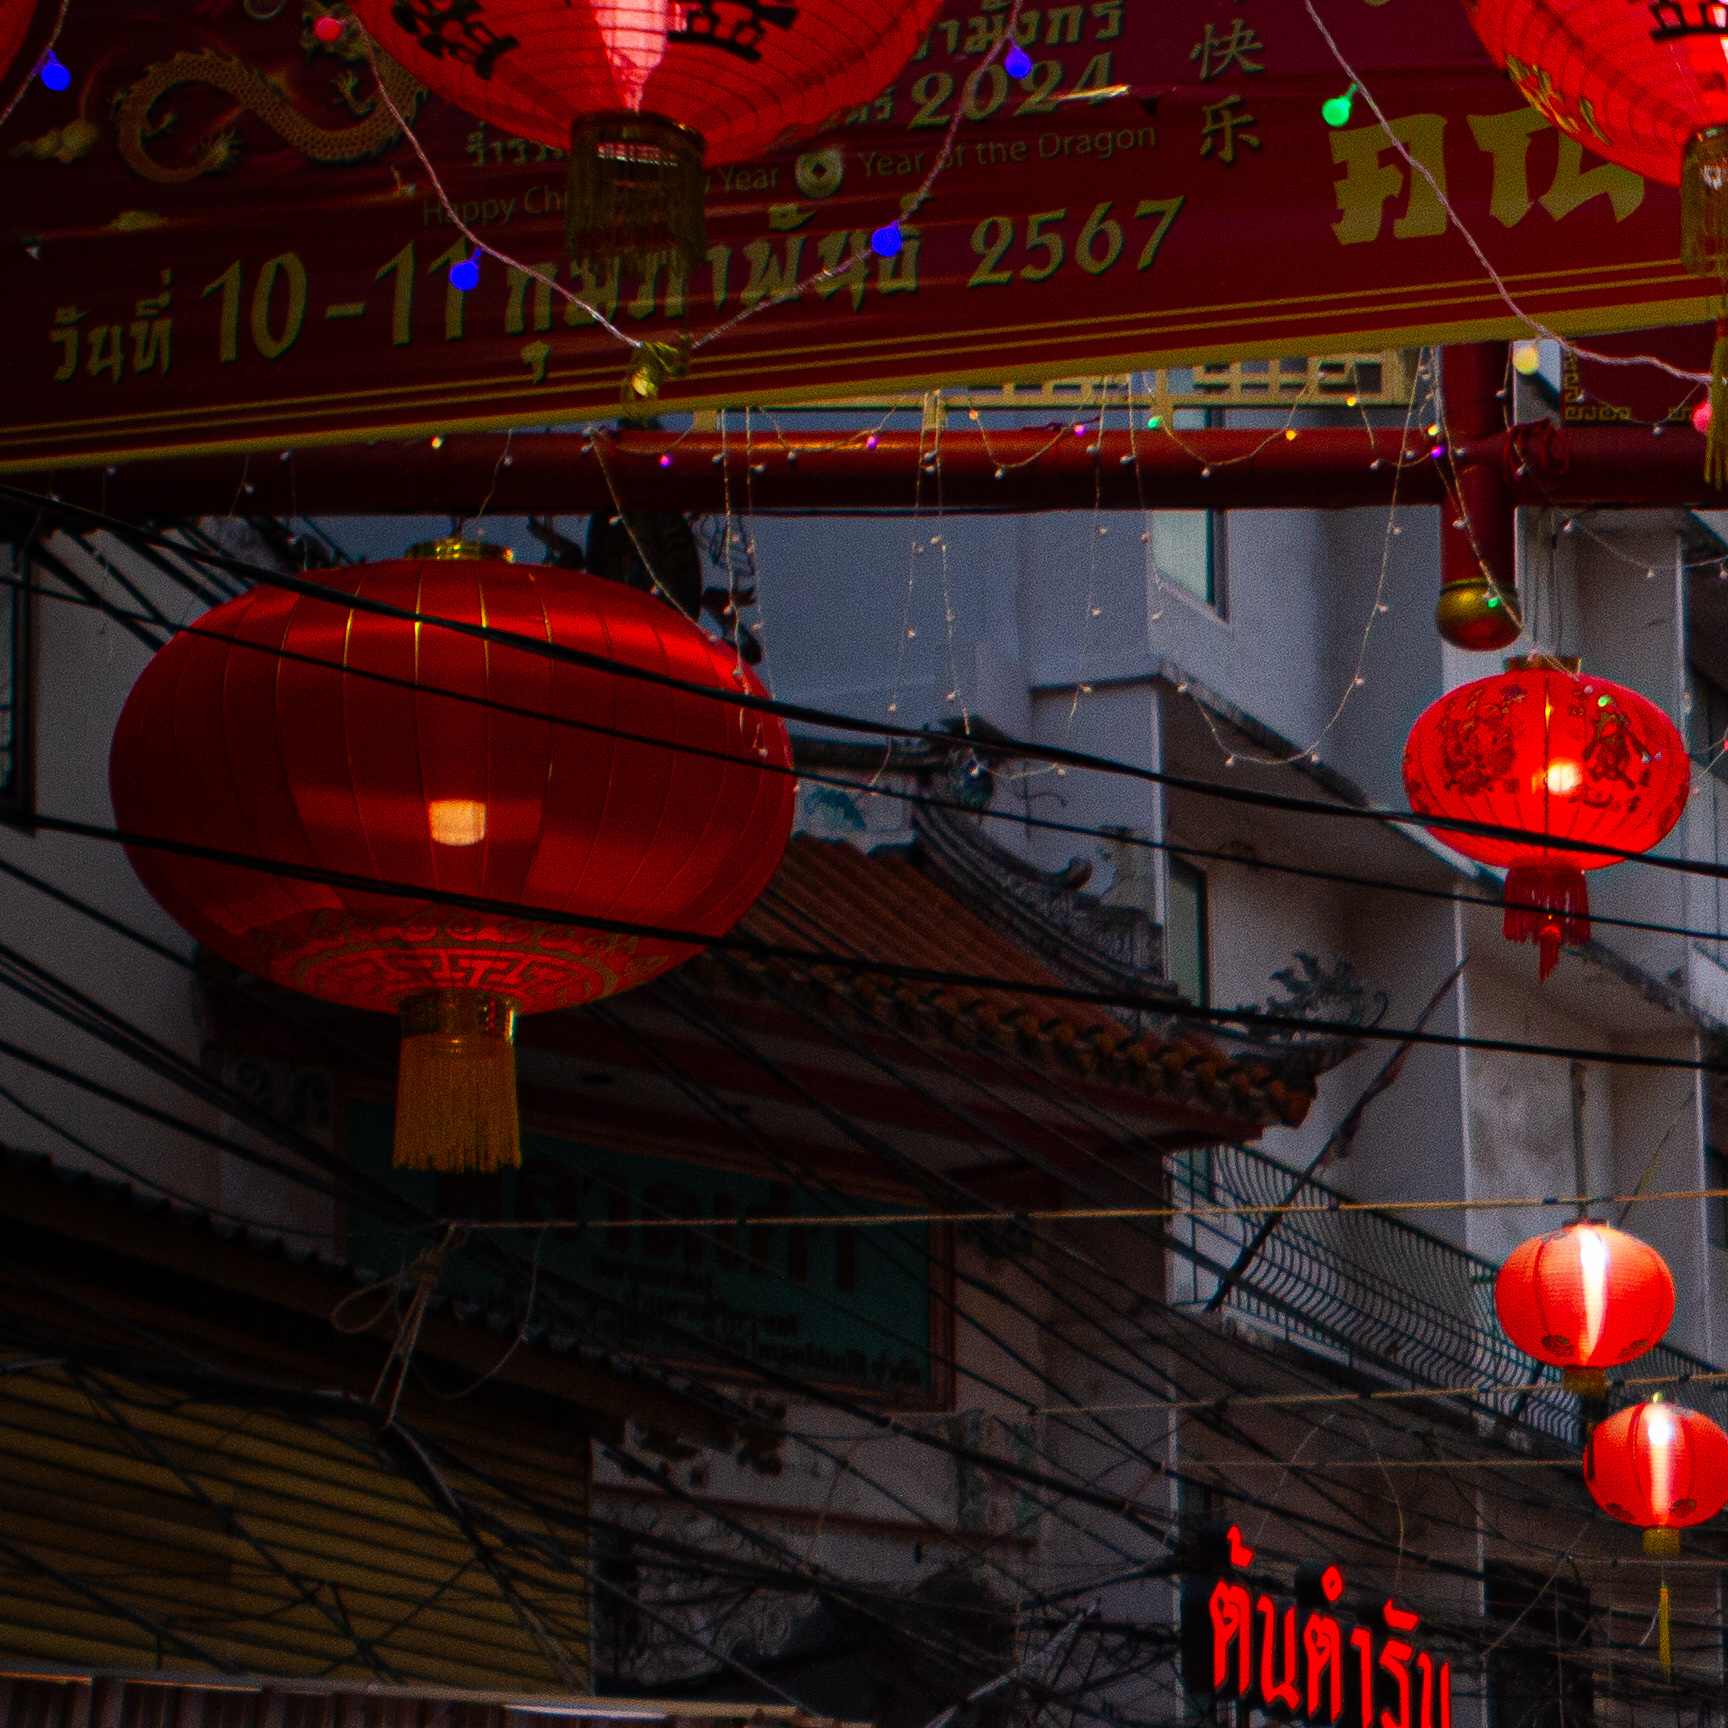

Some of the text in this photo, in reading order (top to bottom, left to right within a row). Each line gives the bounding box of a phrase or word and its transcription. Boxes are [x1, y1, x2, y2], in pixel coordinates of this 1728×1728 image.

[907, 51, 1114, 131] 2024
[423, 197, 516, 228] Happy
[720, 164, 780, 192] Year
[859, 150, 924, 179] Year
[936, 142, 967, 169] of
[976, 136, 1028, 166] the
[1038, 124, 1158, 162] Dragon
[49, 268, 173, 385] วันที่
[966, 195, 1187, 291] 2567
